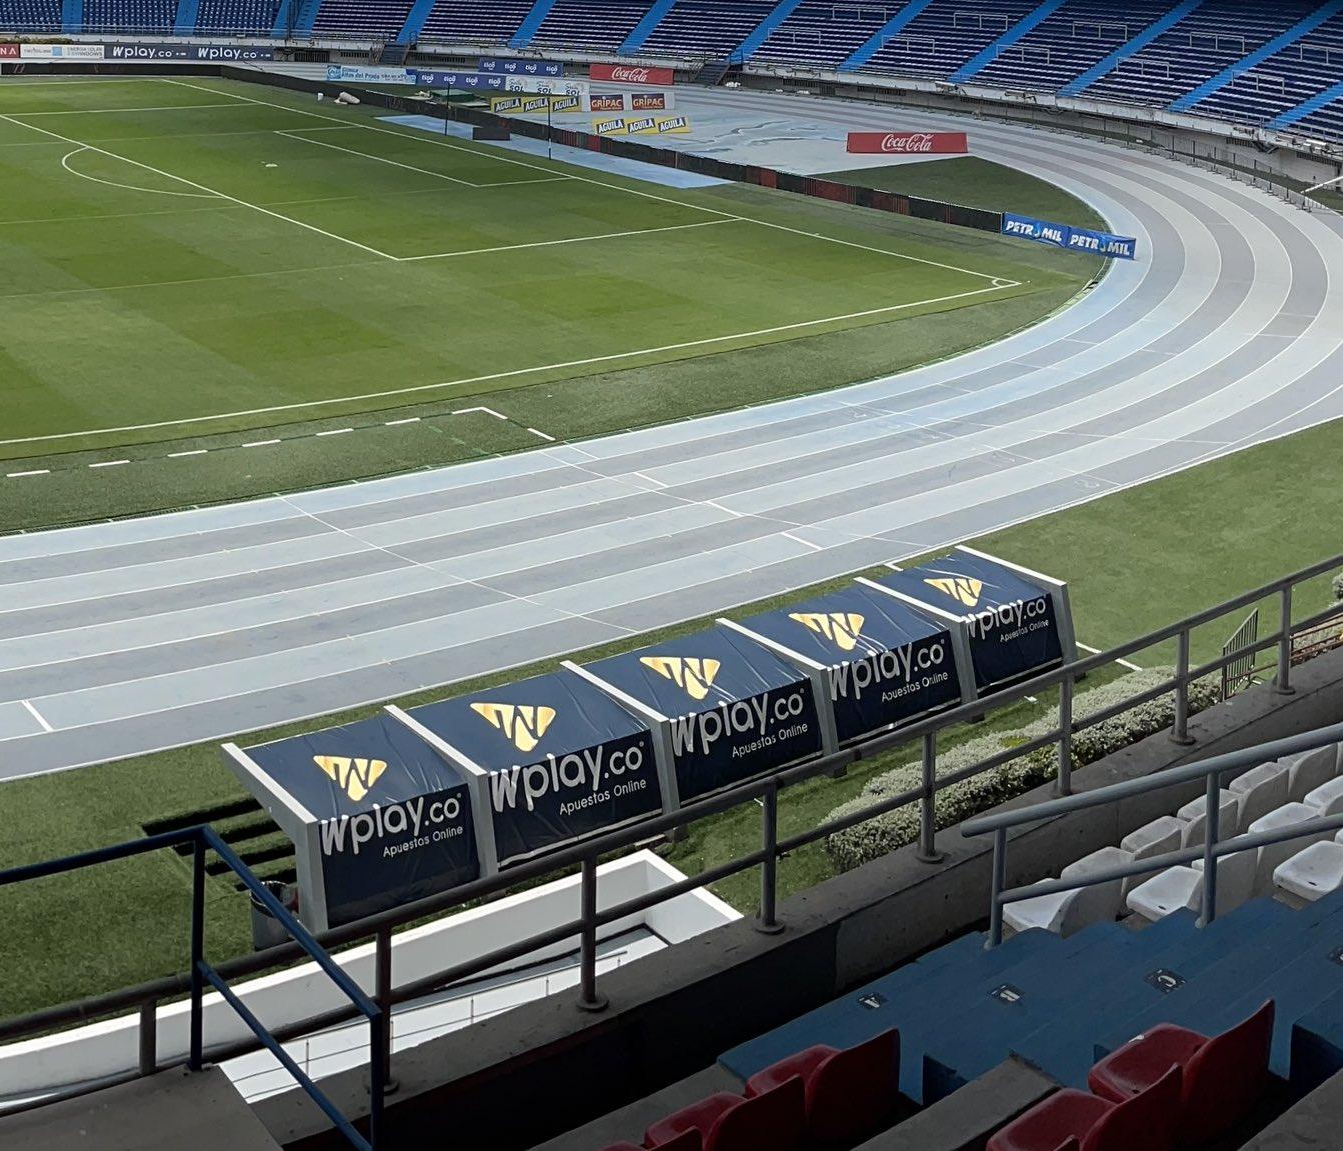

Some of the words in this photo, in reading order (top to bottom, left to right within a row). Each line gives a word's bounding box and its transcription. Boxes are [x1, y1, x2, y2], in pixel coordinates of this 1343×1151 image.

[881, 682, 921, 703] Apuestas
[922, 671, 949, 688] Online
[731, 735, 776, 758] Apuestas
[778, 723, 808, 741] Online
[559, 789, 611, 817] Apuestas
[613, 778, 647, 798] Online
[383, 833, 430, 858] Apuestas
[432, 824, 464, 842] Online
